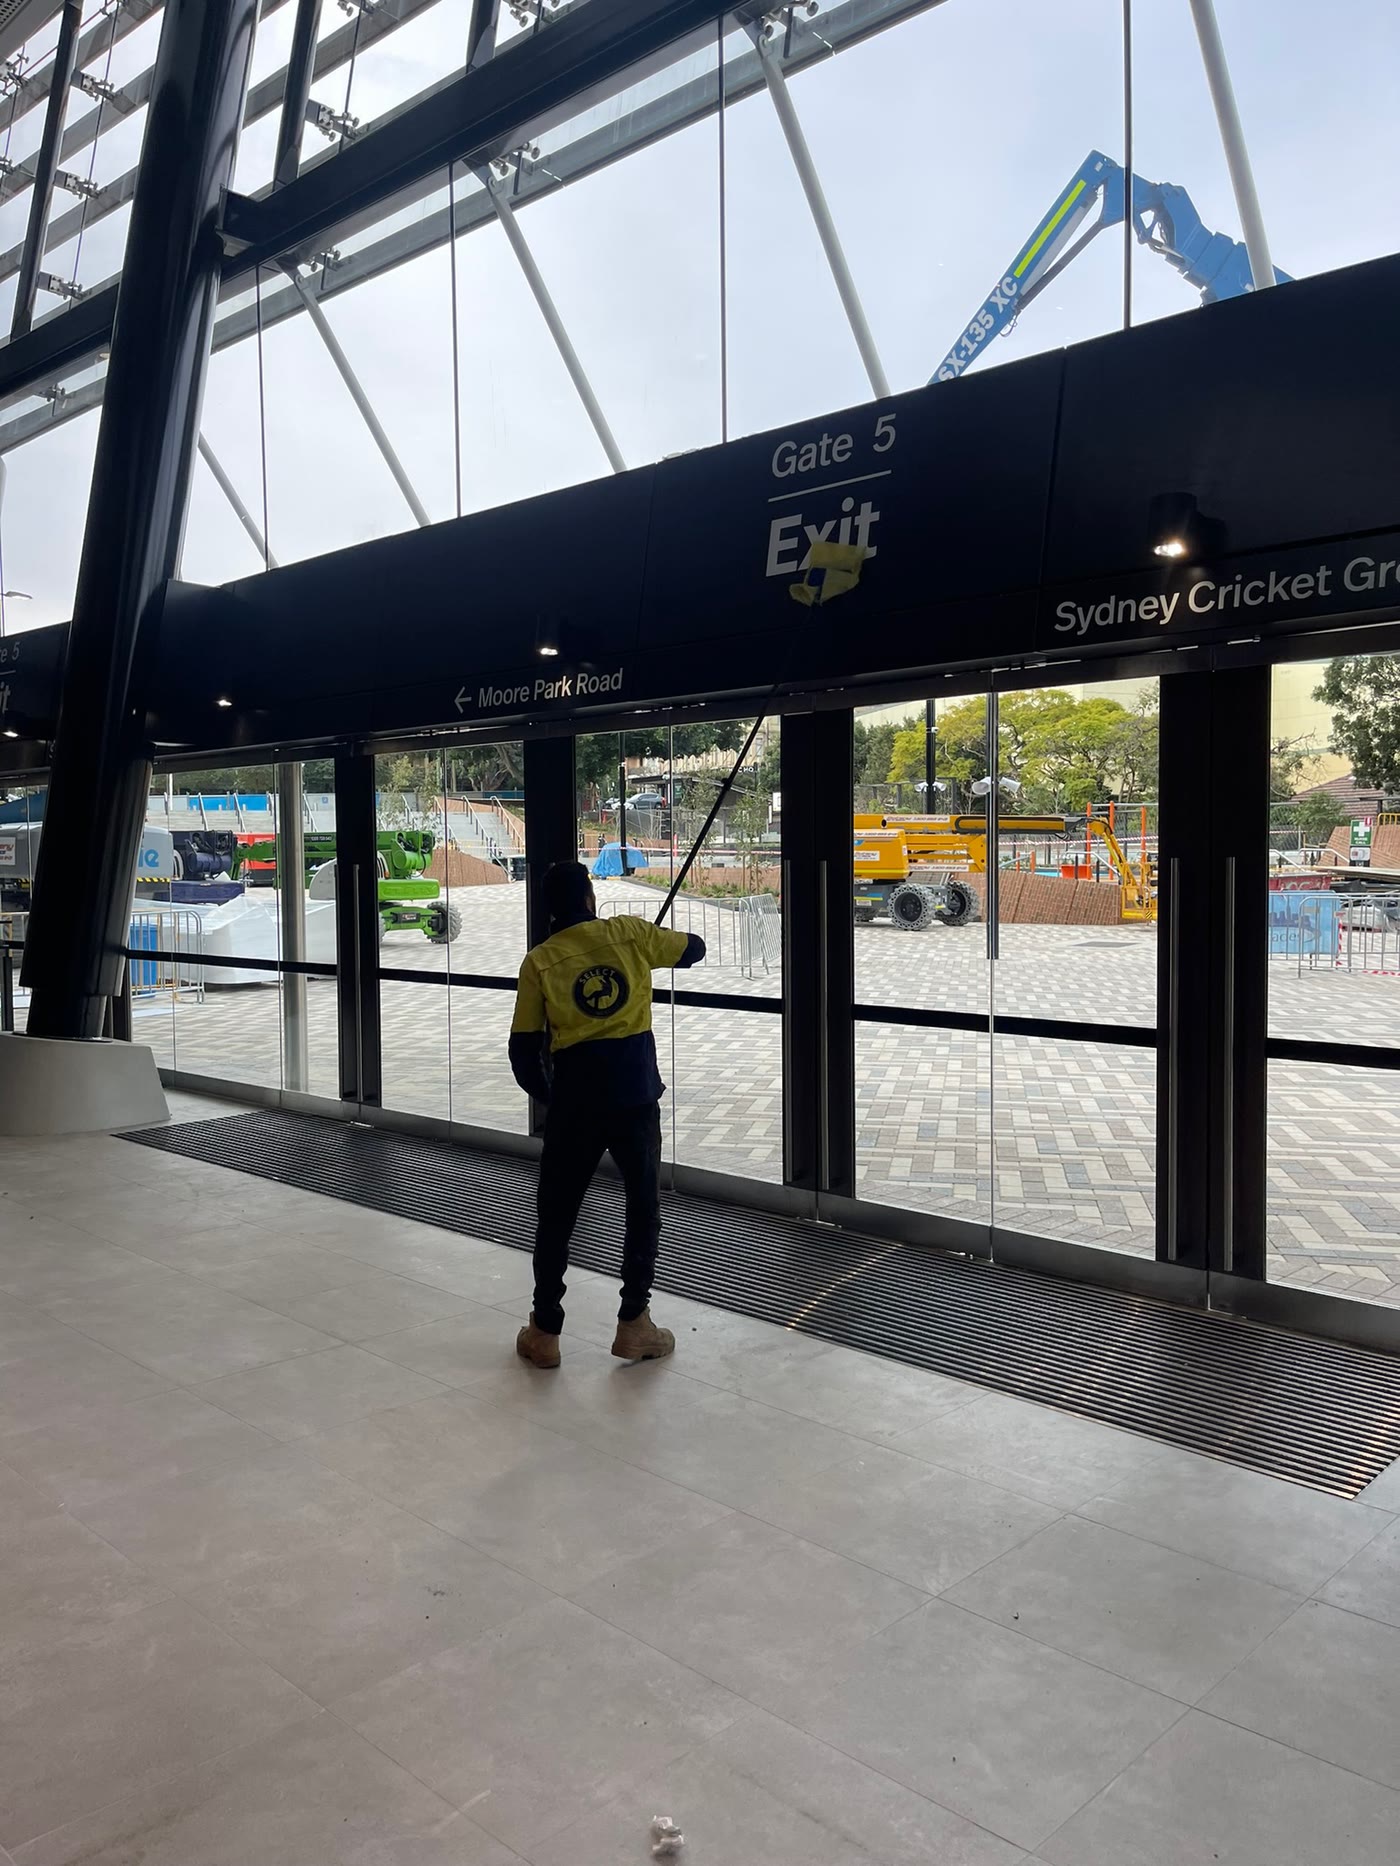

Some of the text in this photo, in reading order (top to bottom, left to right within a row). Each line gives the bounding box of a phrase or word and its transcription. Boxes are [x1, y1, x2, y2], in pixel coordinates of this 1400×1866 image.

[938, 276, 1018, 382] SX-135 XC
[771, 412, 897, 478] Gate 5
[765, 496, 881, 578] Exit
[1053, 592, 1181, 635] Sydney
[1188, 564, 1332, 613] Cricket
[12, 641, 21, 661] 5
[478, 667, 624, 708] Moore Park Road
[579, 968, 616, 985] SELECT
